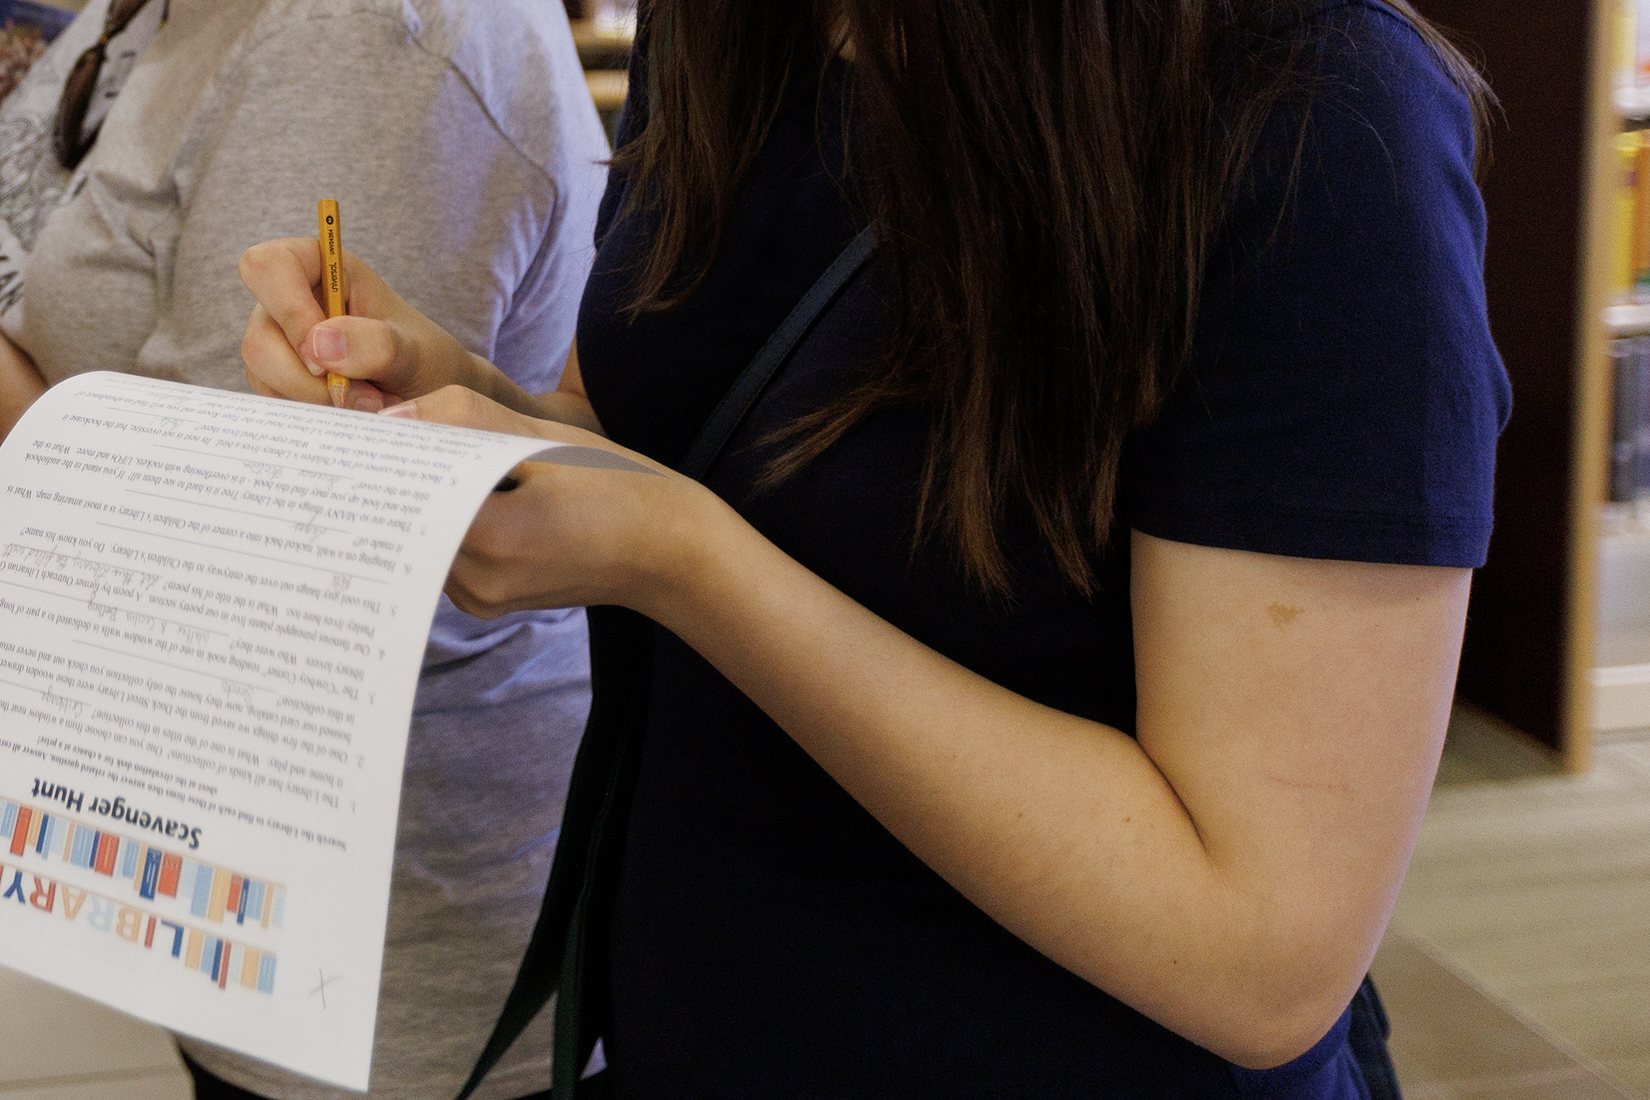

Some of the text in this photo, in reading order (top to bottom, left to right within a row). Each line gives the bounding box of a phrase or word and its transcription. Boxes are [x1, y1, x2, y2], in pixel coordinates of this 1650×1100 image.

[69, 416, 104, 428] bookcase
[102, 421, 116, 429] the
[114, 424, 129, 432] but
[33, 441, 45, 450] the
[45, 443, 53, 451] is
[52, 444, 73, 455] What
[24, 453, 62, 466] audiobook
[94, 452, 112, 460] and
[111, 454, 135, 466] UFOs
[62, 459, 75, 469] the
[74, 461, 84, 470] in
[81, 463, 104, 473] stand
[103, 466, 120, 475] you
[117, 470, 127, 479] If
[142, 474, 164, 486] them
[7, 486, 15, 495] is
[14, 488, 34, 499] What
[53, 492, 84, 506] amazing
[83, 501, 103, 510] most
[109, 506, 118, 515] is
[118, 505, 146, 522] Library
[44, 532, 57, 543] his
[57, 535, 78, 548] know
[78, 539, 94, 548] you
[2, 543, 24, 557] with
[93, 543, 106, 554] Do
[6, 565, 40, 581] Librarian
[39, 573, 74, 589] Outreach
[75, 581, 100, 595] former
[101, 584, 112, 598] by
[112, 589, 136, 600] poem
[15, 607, 25, 617] of
[26, 609, 42, 619] pair
[47, 615, 56, 624] to
[55, 617, 92, 635] dedicated
[92, 626, 100, 636] is
[101, 628, 122, 639] walls
[123, 633, 154, 648] window
[17, 647, 38, 658] never
[37, 652, 52, 663] and
[53, 656, 66, 666] out
[66, 660, 89, 674] check
[25, 667, 55, 681] wooden
[90, 665, 106, 676] you
[56, 675, 76, 689] these
[106, 670, 144, 688] collection
[77, 681, 96, 692] were
[146, 678, 164, 693] only
[97, 684, 126, 704] Library
[41, 685, 83, 719] Cribbage
[127, 695, 150, 711] Street
[11, 705, 27, 716] near
[28, 710, 58, 726] window
[65, 721, 84, 736] from
[85, 726, 112, 743] choose
[136, 723, 151, 736] this
[152, 728, 161, 740] in
[113, 735, 128, 745] can
[129, 739, 146, 751] you
[12, 744, 21, 754] all
[23, 747, 44, 762] Answer
[64, 745, 71, 753] at
[73, 747, 96, 762] chance
[146, 744, 164, 759] One
[104, 757, 115, 768] for
[116, 760, 133, 774] desk
[80, 765, 106, 779] related
[134, 765, 174, 784] circulation
[108, 773, 119, 784] the
[121, 777, 146, 790] answer
[175, 778, 187, 789] the
[148, 785, 164, 798] then
[189, 782, 197, 790] at
[198, 784, 218, 798] sheet
[166, 790, 186, 805] items
[188, 797, 207, 811] these
[208, 803, 217, 813] of
[32, 778, 202, 850] Scavenger Hunt
[218, 806, 237, 818] each
[238, 812, 255, 826] find
[256, 817, 265, 827] to
[267, 818, 299, 839] Library
[302, 830, 315, 843] the
[317, 835, 347, 853] Search
[3, 869, 184, 959] LIBRARY
